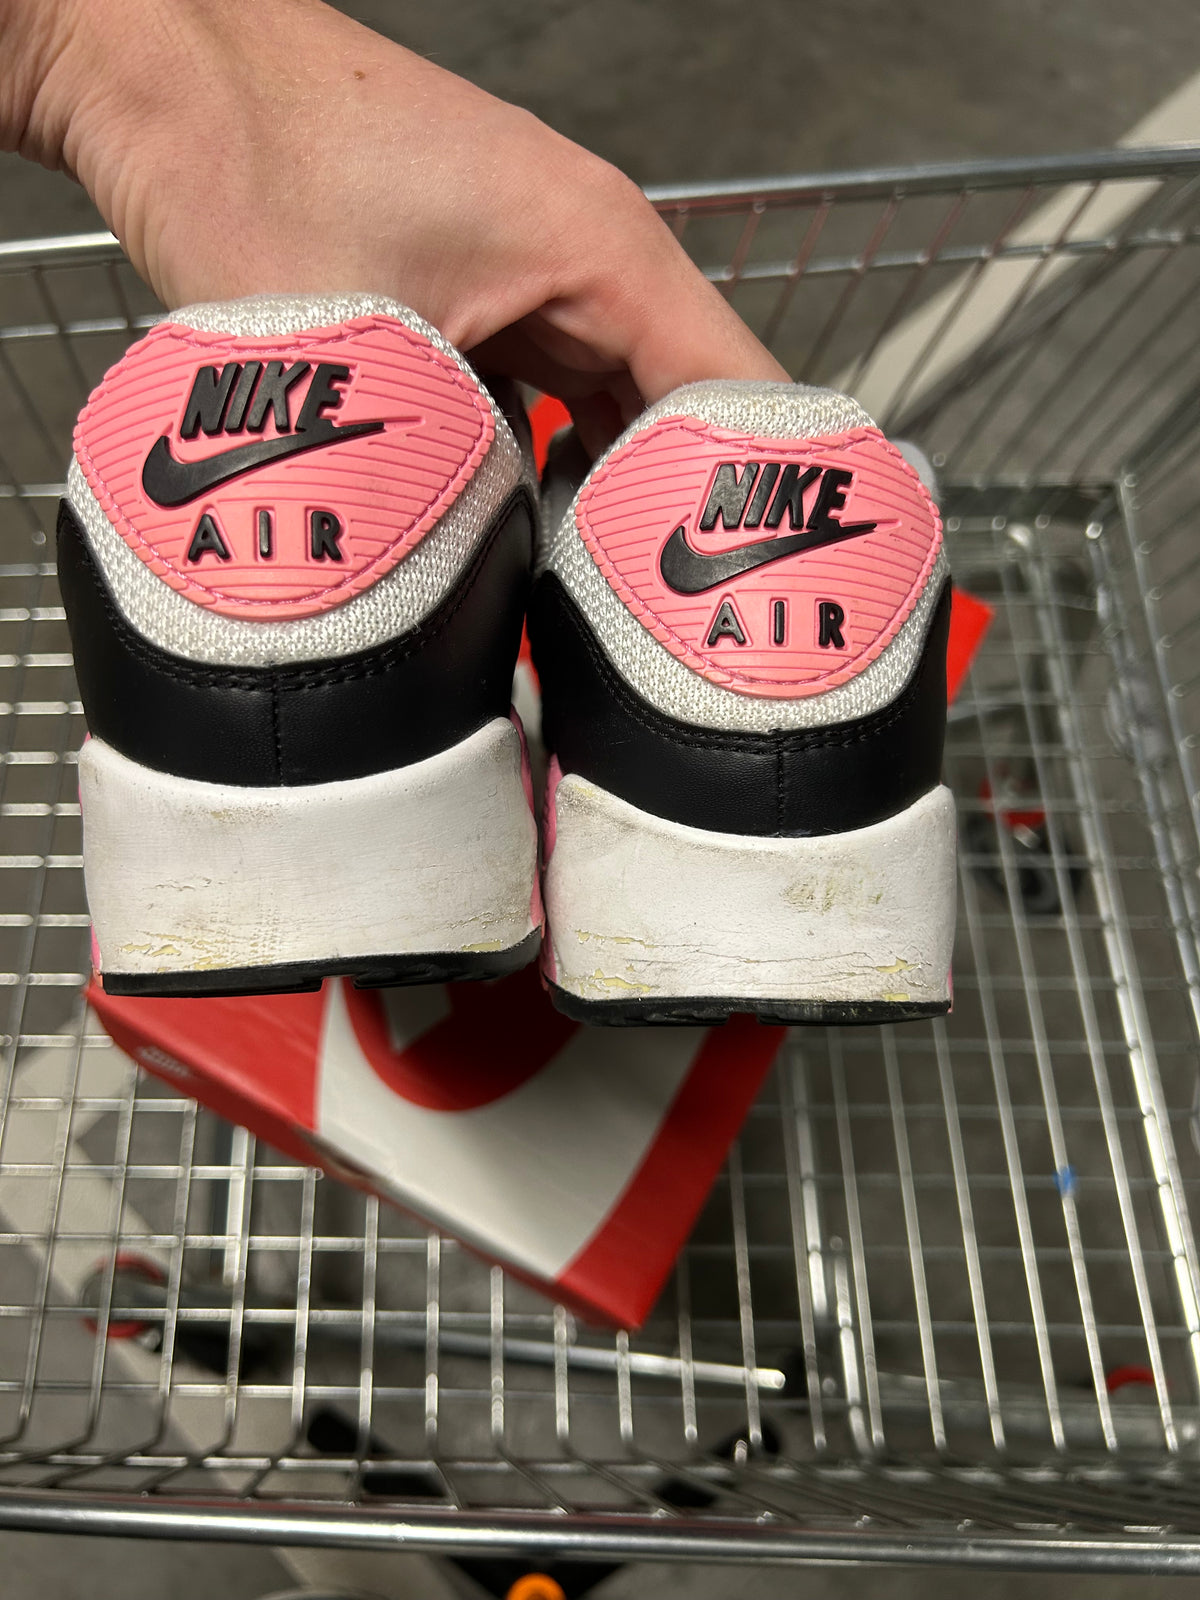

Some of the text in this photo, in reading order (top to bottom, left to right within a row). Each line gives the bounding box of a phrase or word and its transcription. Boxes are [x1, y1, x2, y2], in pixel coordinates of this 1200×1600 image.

[180, 361, 350, 440] NIKE
[700, 463, 853, 531] NIKE
[188, 510, 342, 562] AIR
[707, 601, 845, 648] AIR
